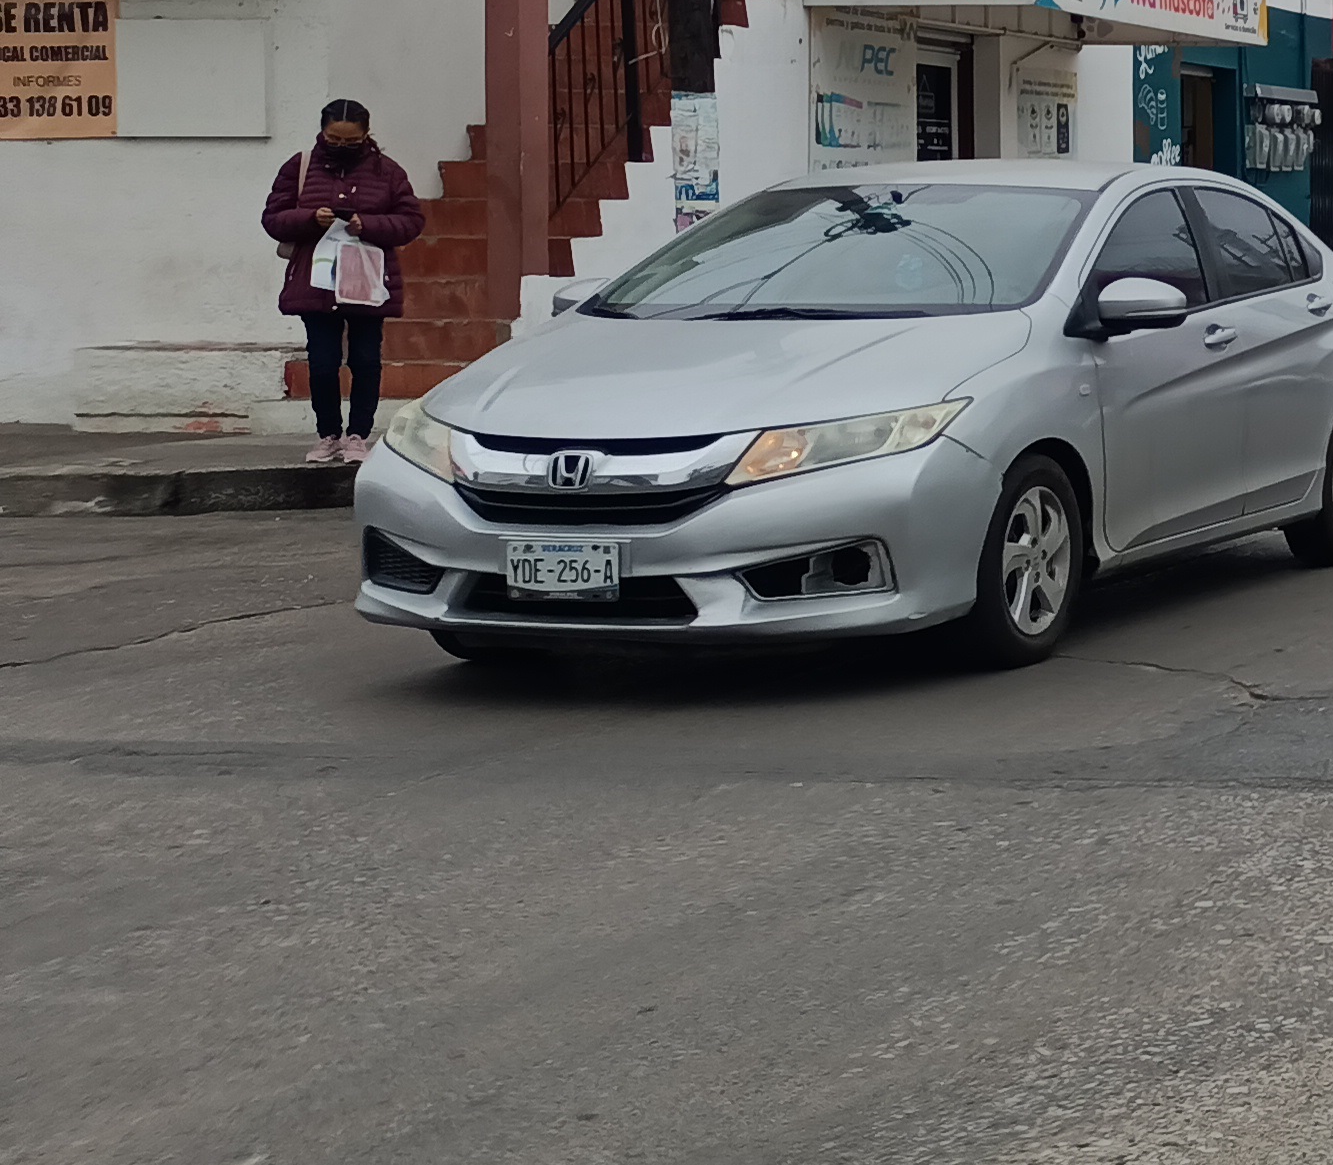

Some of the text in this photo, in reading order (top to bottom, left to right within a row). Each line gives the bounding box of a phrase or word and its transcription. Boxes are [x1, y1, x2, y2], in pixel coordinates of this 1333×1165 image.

[0, 1, 109, 34] E RENTA
[29, 45, 109, 62] COMERCIAL
[12, 75, 82, 87] INFORMES
[26, 95, 58, 117] 138
[61, 95, 83, 117] 61
[87, 95, 113, 117] 09
[510, 558, 614, 585] YDE-256-A
